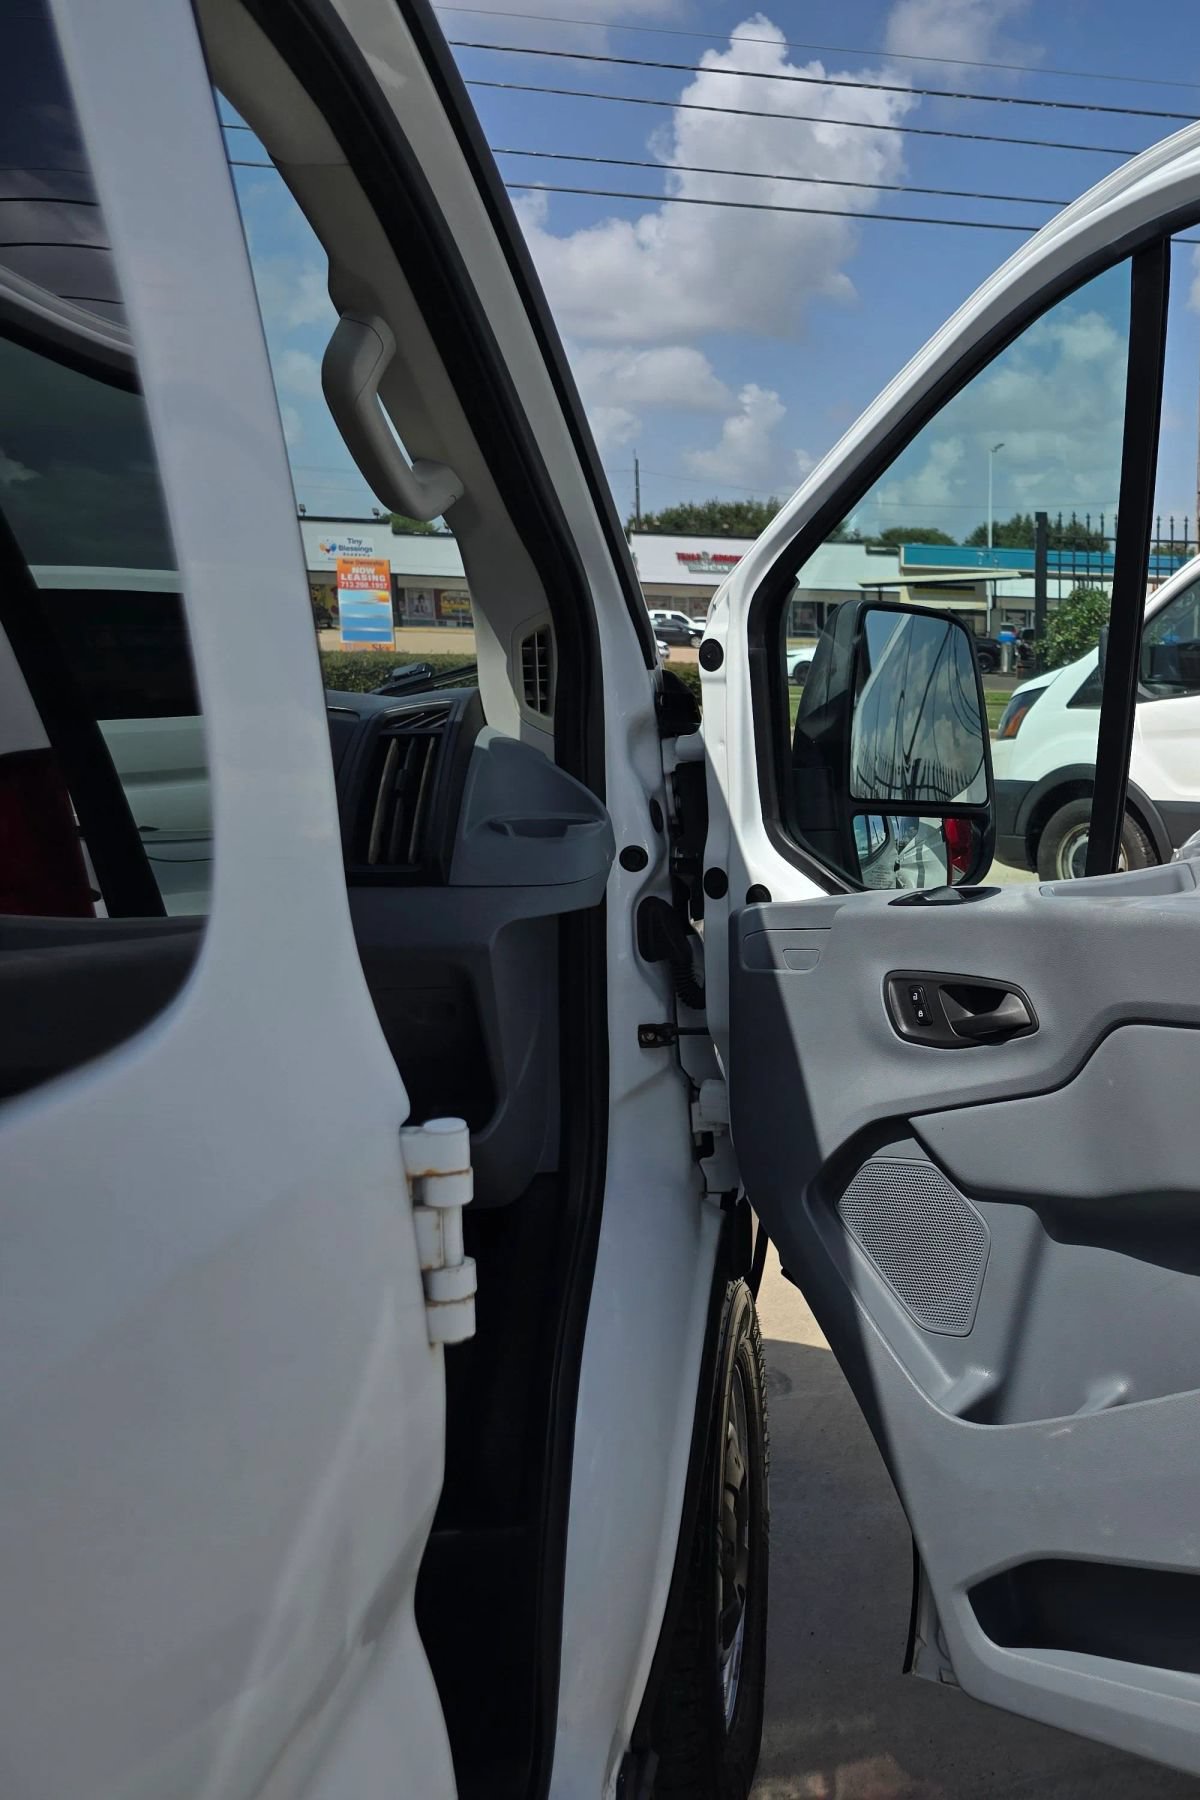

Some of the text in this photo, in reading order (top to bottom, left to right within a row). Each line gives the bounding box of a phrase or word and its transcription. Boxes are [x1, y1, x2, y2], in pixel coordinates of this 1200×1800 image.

[347, 538, 362, 546] Tiny
[338, 545, 373, 553] Blessings
[341, 574, 386, 582] LEASING
